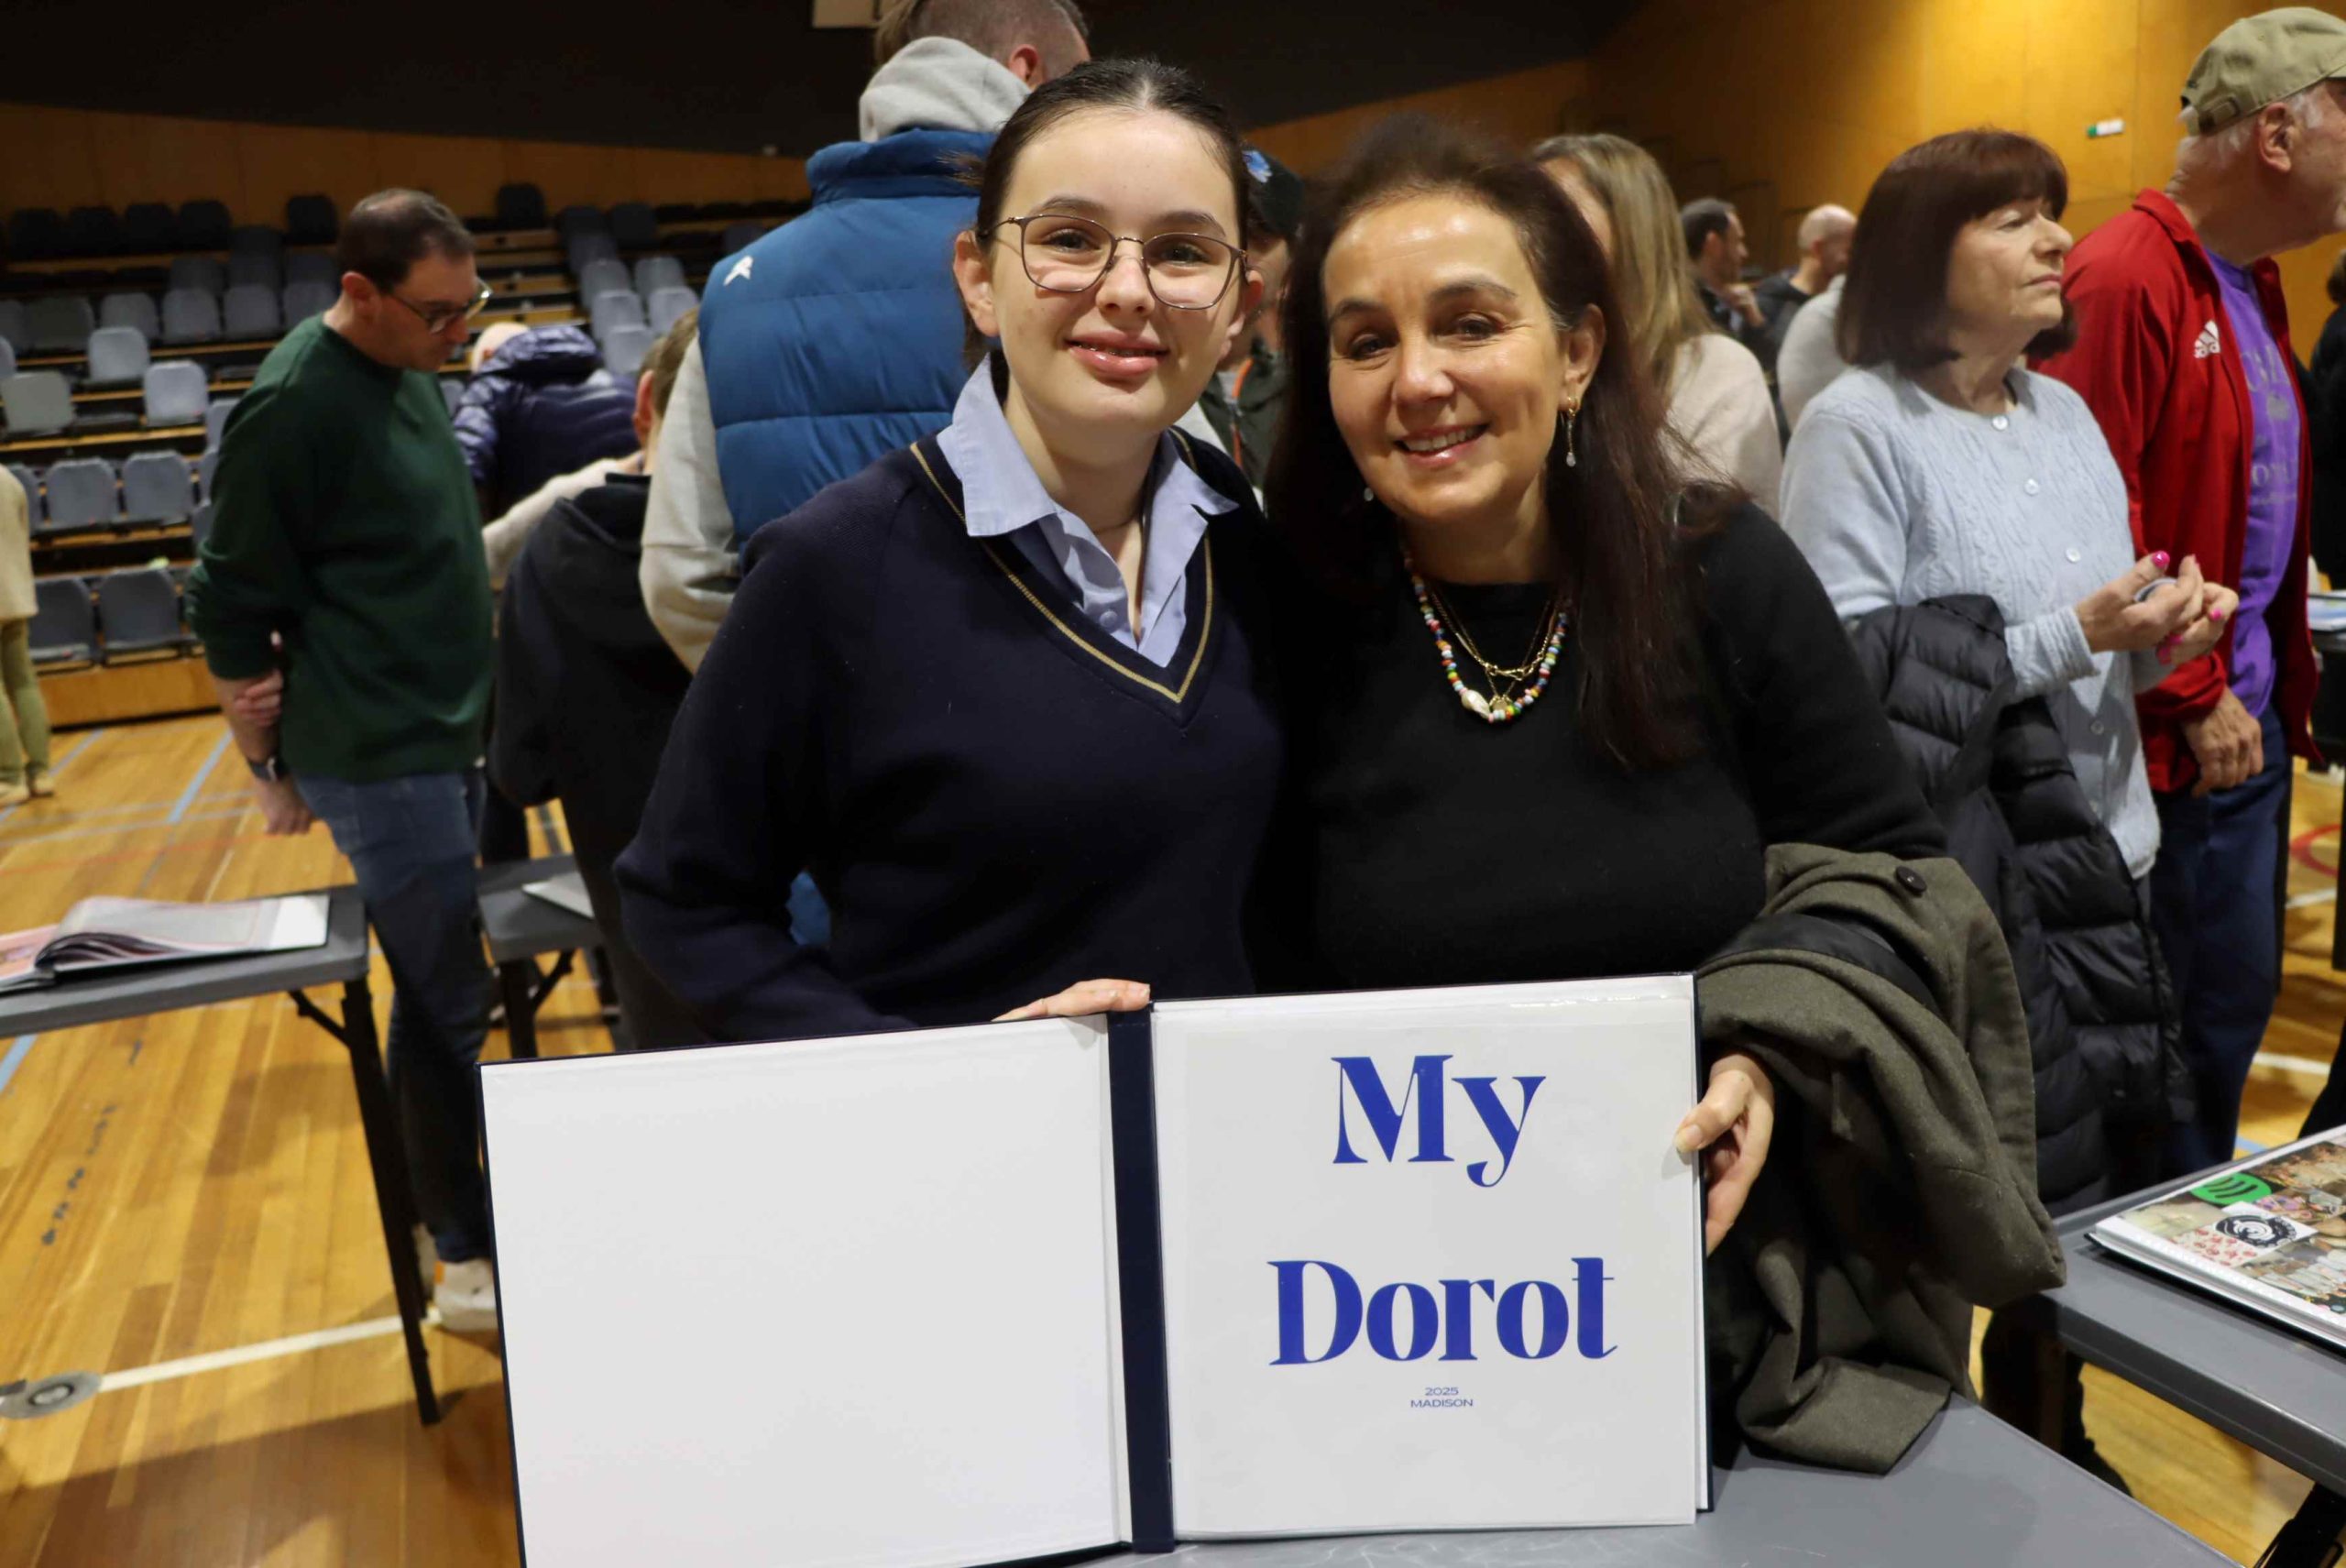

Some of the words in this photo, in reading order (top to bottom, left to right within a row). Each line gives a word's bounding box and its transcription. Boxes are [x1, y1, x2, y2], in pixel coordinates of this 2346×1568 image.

[1330, 1054, 1547, 1188] My
[1266, 1256, 1618, 1365] Dorot
[1410, 1398, 1474, 1408] MADISON
[1424, 1387, 1460, 1396] 2025
